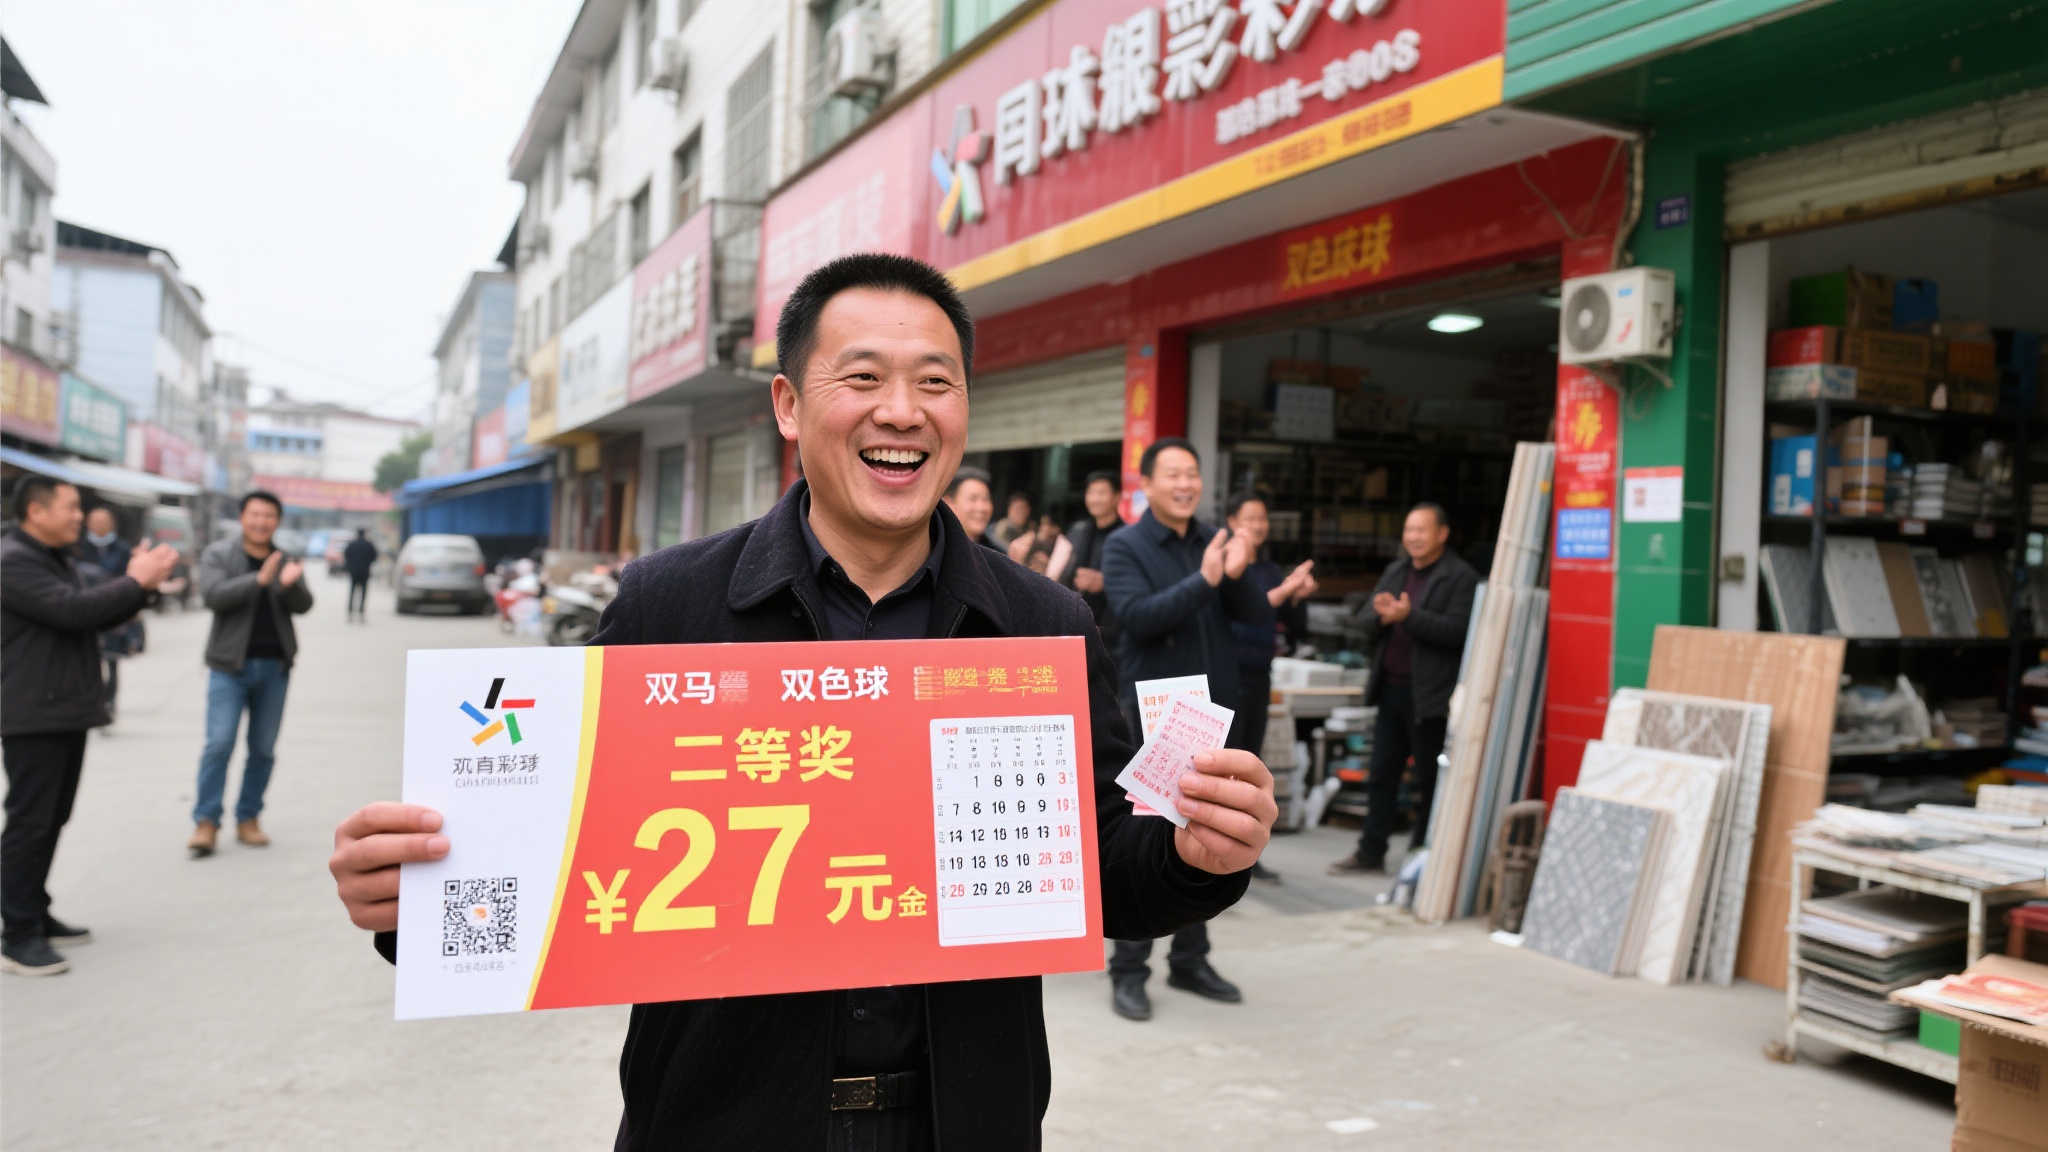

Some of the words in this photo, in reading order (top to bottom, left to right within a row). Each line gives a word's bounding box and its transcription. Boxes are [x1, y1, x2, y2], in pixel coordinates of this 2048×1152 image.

[780, 665, 889, 702] 双色球
[670, 725, 854, 784] 二等奖
[952, 803, 960, 817] 7
[1038, 799, 1046, 813] 9
[971, 828, 985, 842] 12
